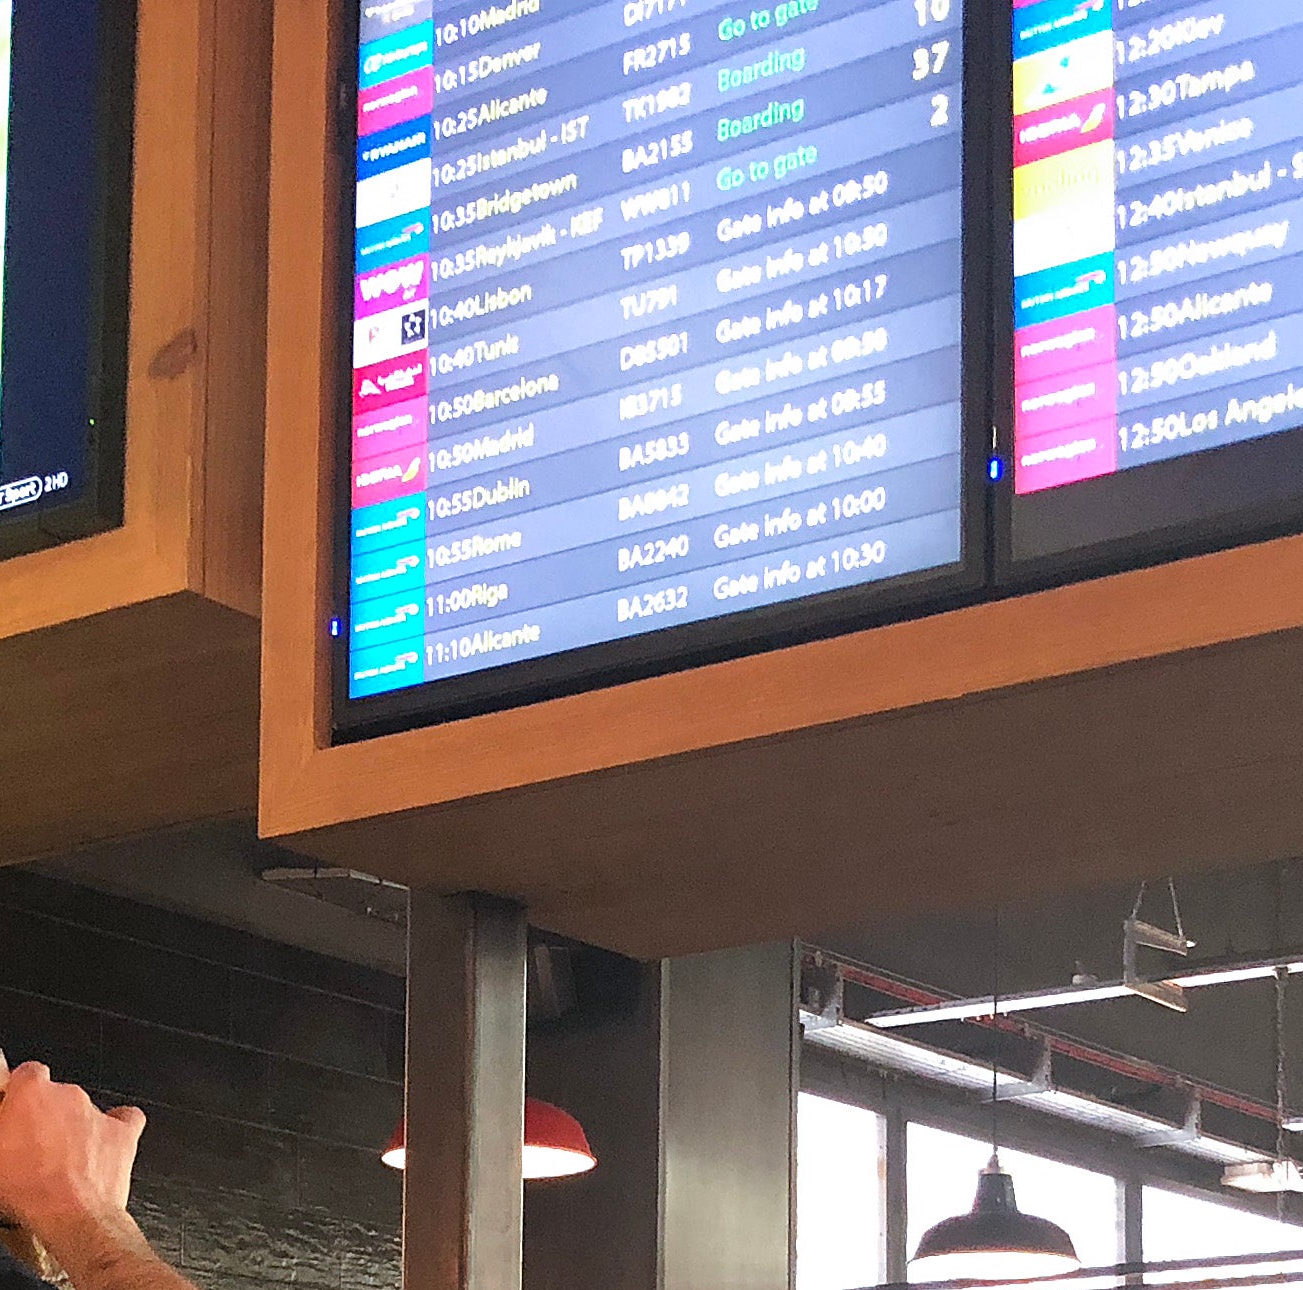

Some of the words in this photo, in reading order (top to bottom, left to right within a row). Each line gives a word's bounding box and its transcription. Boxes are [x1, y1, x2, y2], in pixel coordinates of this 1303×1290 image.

[624, 33, 690, 75] FR2715
[774, 0, 819, 26] gate
[718, 45, 805, 91] Boarding
[622, 130, 693, 172] BA2155
[717, 96, 805, 142] Boarding
[913, 41, 949, 80] 37
[774, 145, 819, 178] gate
[930, 94, 948, 126] 2
[618, 535, 689, 571] BA2240
